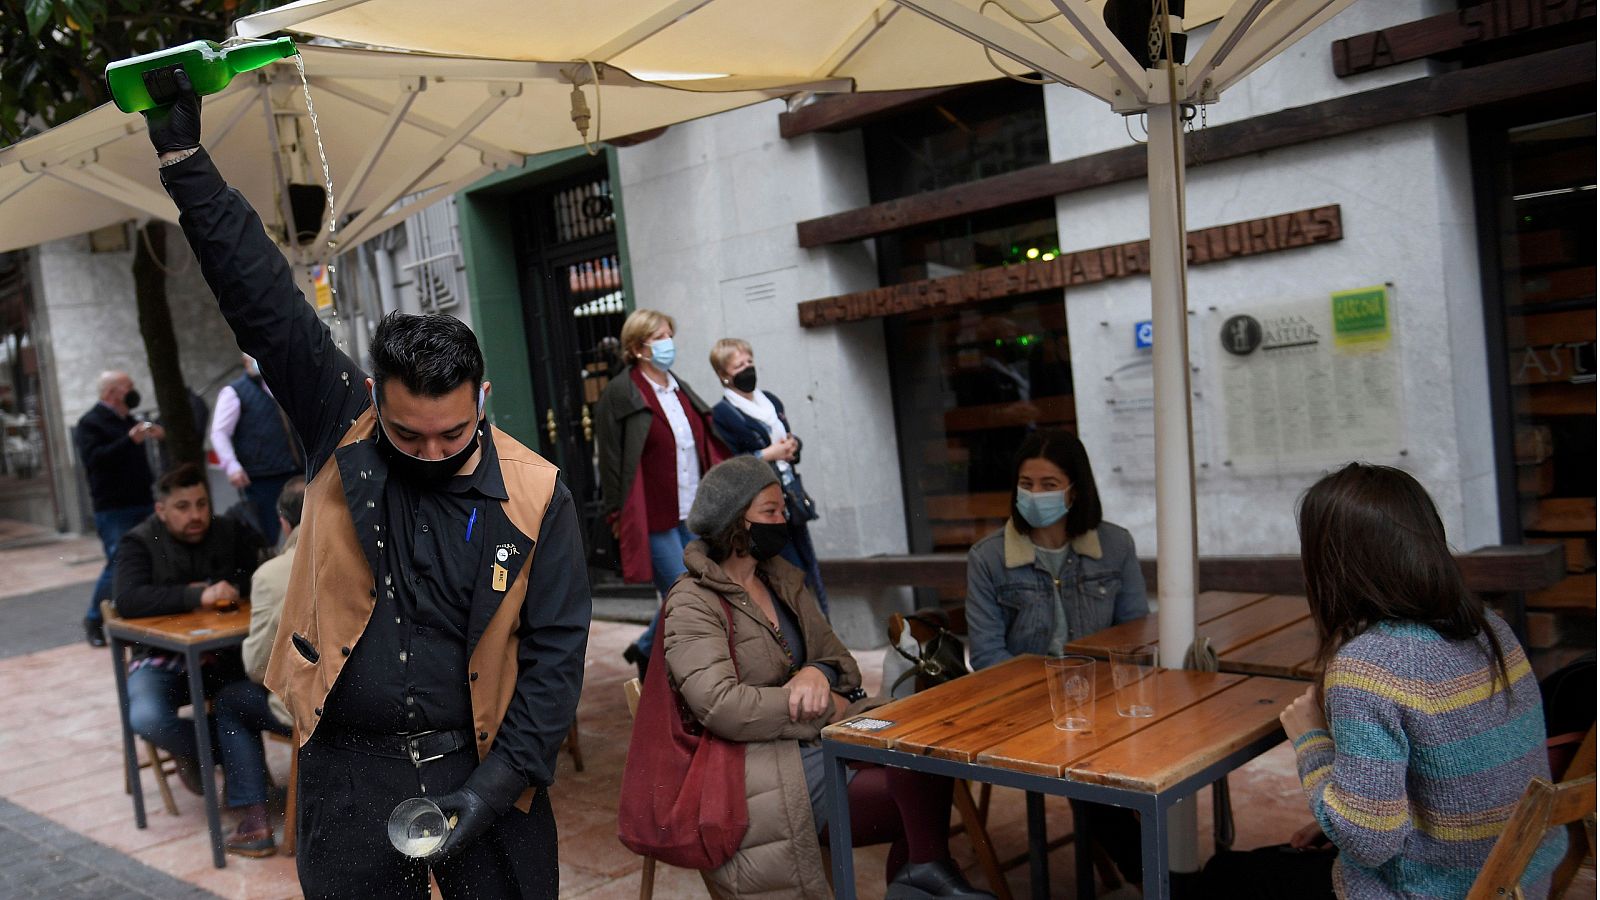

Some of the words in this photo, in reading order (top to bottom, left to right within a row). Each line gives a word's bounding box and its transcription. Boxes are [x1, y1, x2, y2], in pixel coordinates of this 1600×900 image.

[1340, 31, 1395, 72] LA
[1004, 252, 1087, 294] SAVIA
[1187, 207, 1334, 266] STURIAS
[1518, 342, 1597, 379] AST
